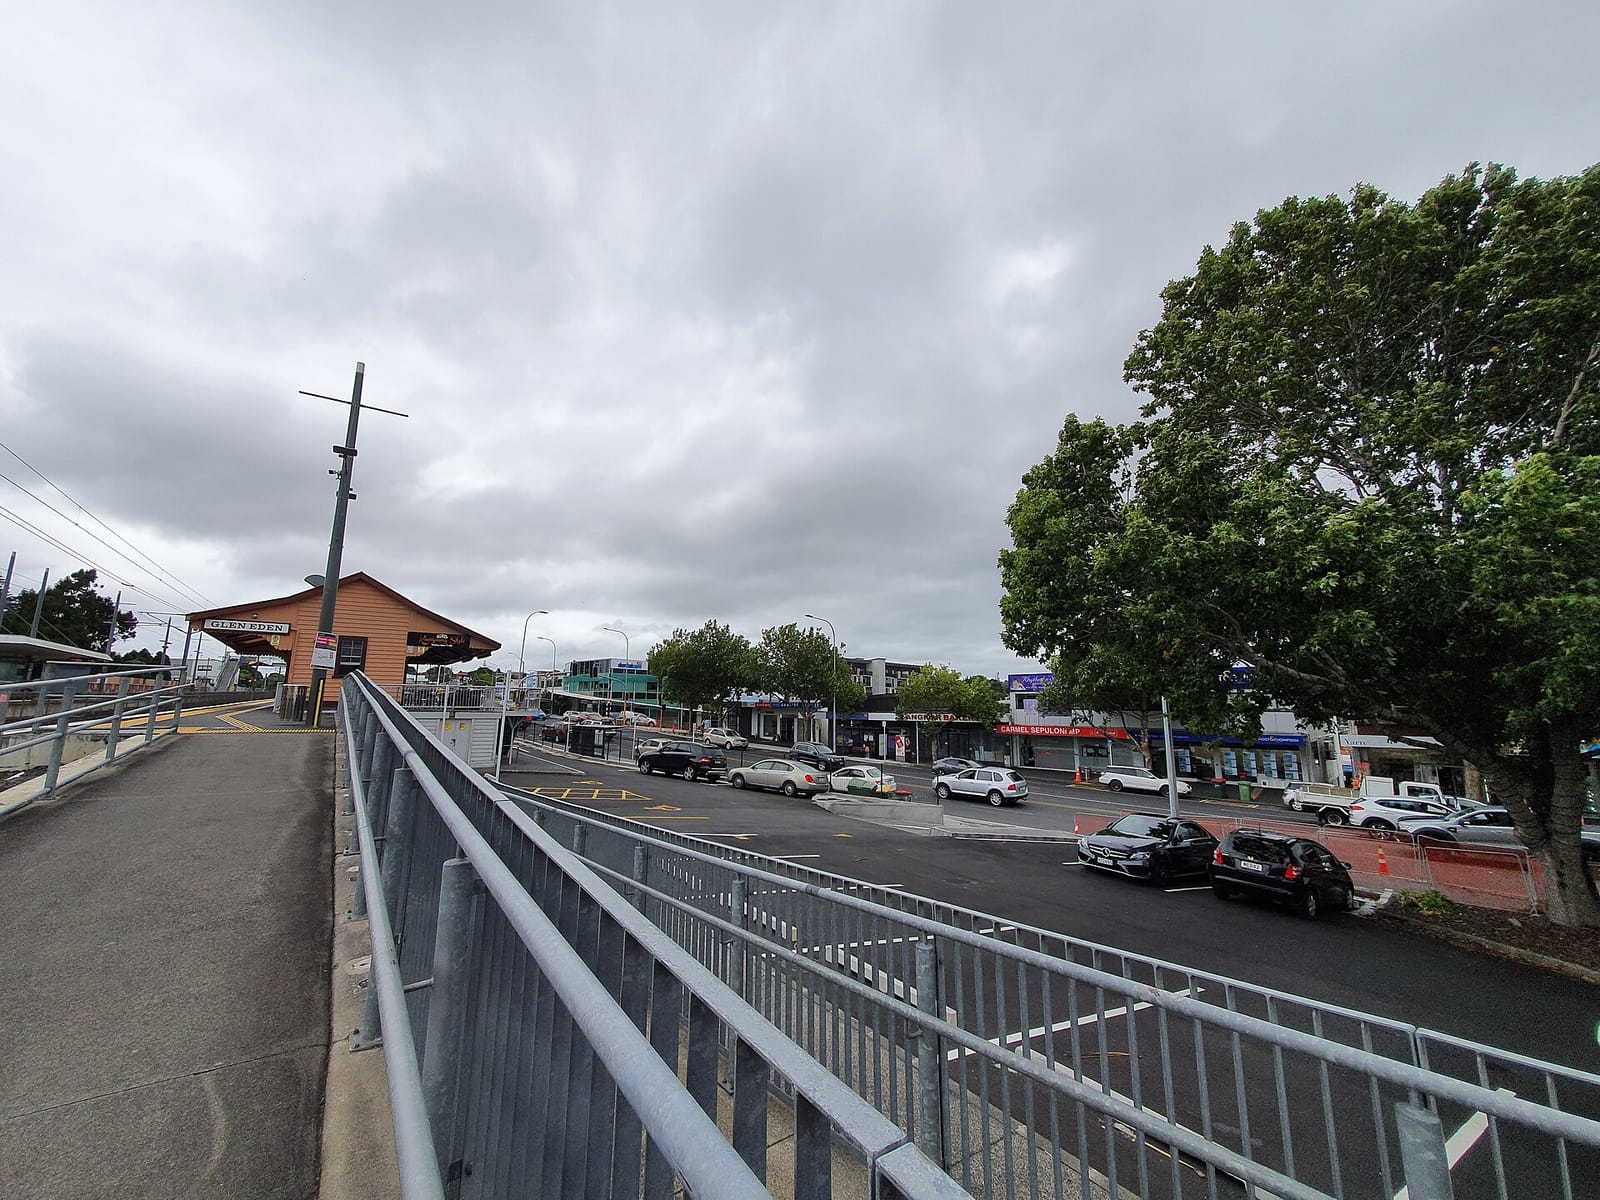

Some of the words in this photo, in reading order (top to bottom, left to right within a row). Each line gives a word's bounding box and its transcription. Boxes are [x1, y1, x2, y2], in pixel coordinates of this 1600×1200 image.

[211, 620, 245, 629] GLEN
[249, 623, 283, 632] EDEN
[1000, 725, 1029, 734] CARMEL
